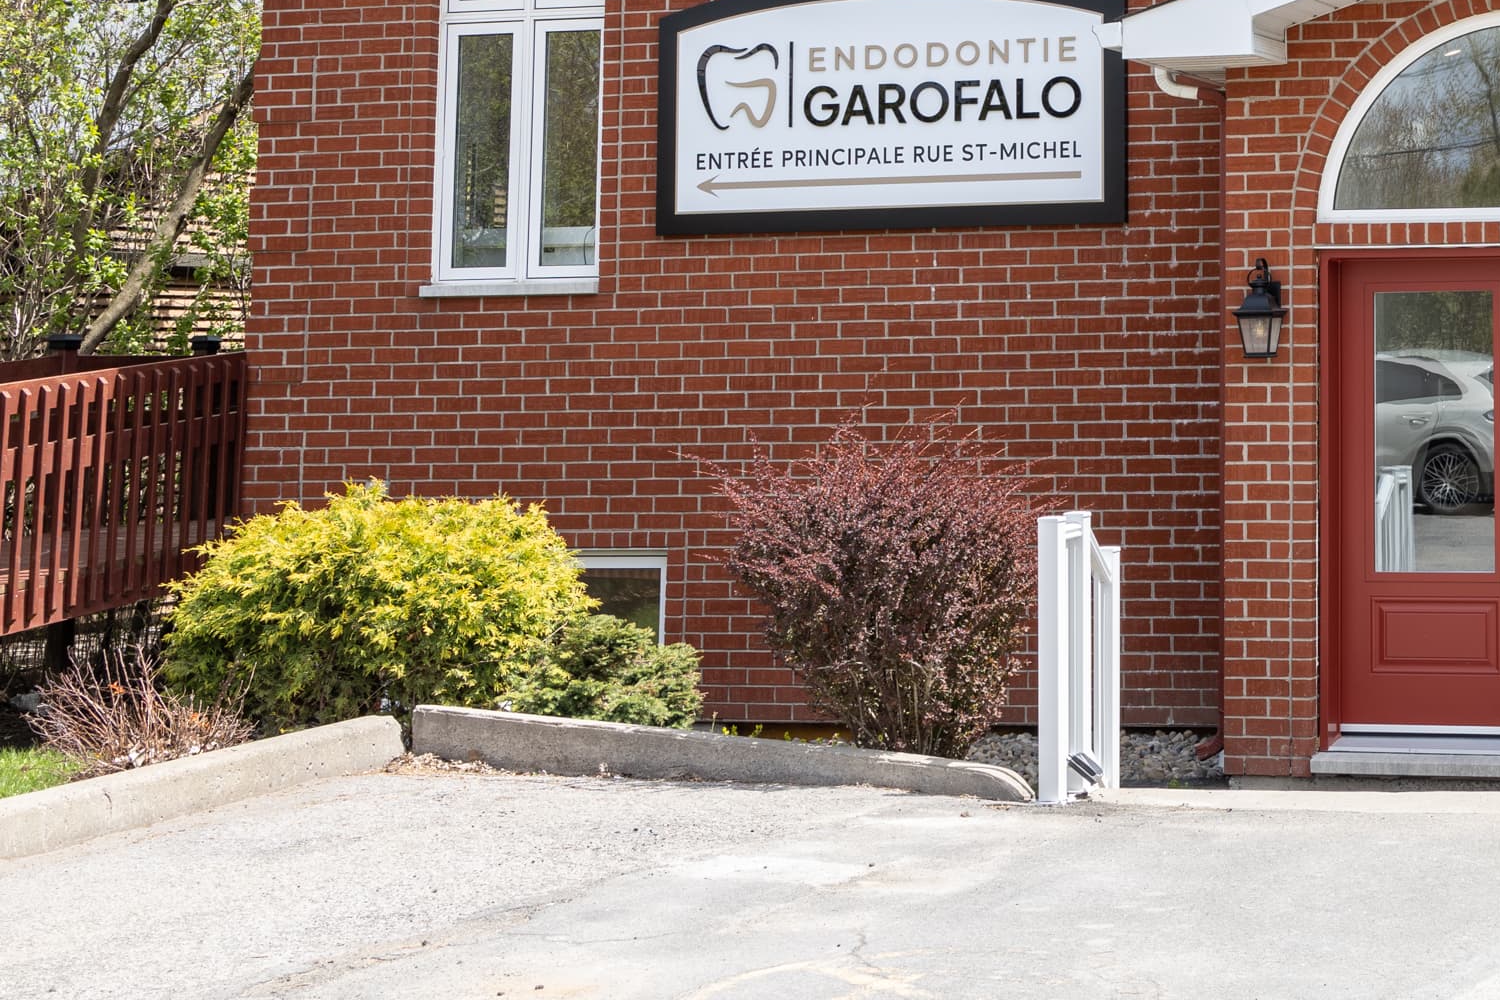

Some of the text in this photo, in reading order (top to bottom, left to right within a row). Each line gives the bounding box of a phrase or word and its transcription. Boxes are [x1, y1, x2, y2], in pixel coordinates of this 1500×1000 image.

[808, 36, 1077, 73] ENDODONTIE
[802, 75, 1083, 129] GAROFALO
[696, 140, 1083, 171] ENTRÉE PRINCIPALE RUE ST-MICHEL
